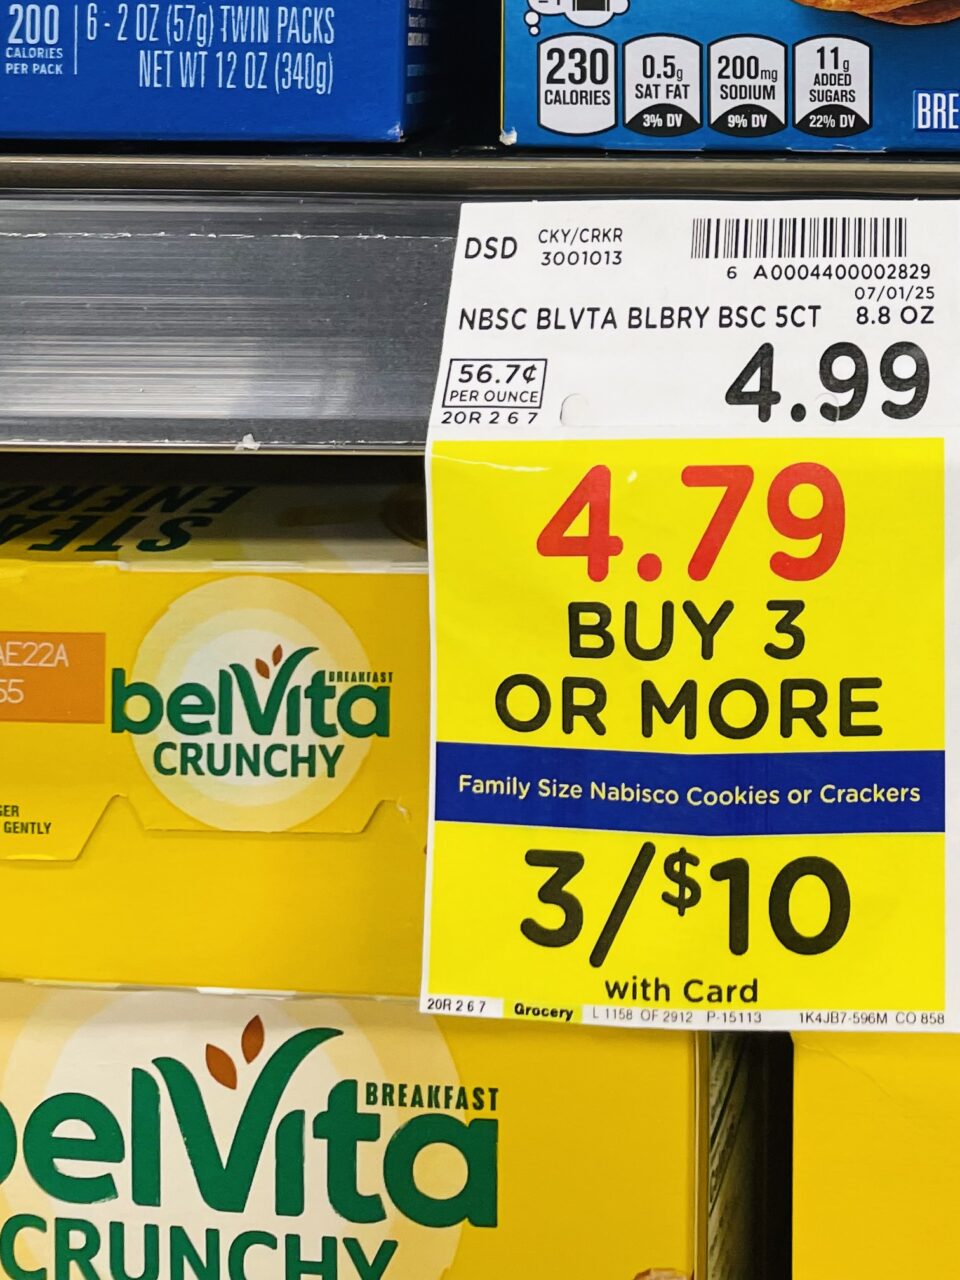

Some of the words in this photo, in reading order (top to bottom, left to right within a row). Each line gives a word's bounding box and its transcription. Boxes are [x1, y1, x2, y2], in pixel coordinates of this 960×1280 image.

[8, 4, 60, 46] 200
[135, 4, 159, 44] OZ
[166, 3, 214, 48] (57g)
[220, 5, 269, 45] TWIN
[278, 6, 335, 45] PACKS
[5, 46, 64, 60] CALORIES
[5, 62, 29, 76] PER
[31, 62, 64, 76] PACK
[139, 49, 174, 89] NET
[179, 49, 208, 89] WT
[216, 50, 235, 90] 12
[245, 51, 268, 91] OZ
[275, 51, 334, 95] (340g)
[545, 47, 609, 85] 230
[813, 72, 852, 87] ADDED
[544, 89, 611, 106] CALORIES
[635, 84, 661, 100] SAT
[666, 84, 690, 100] FAT
[719, 84, 776, 101] SODIUM
[809, 88, 856, 103] SUGARS
[538, 227, 623, 245] CKY/CRKR
[465, 236, 517, 260] DSD
[540, 250, 623, 266] 3001013
[753, 264, 931, 281] A0004400002829
[854, 286, 935, 301] 07/01/25
[459, 307, 527, 331] NBSC
[536, 307, 618, 330] BLVTA
[627, 306, 710, 329] BLBRY
[718, 305, 767, 328] BSC
[775, 305, 822, 328] 5CT
[856, 306, 891, 325] 8.8
[900, 306, 935, 325] OZ
[458, 363, 538, 384] 56.7¢
[725, 341, 930, 423] 4.99
[450, 389, 480, 403] PER
[484, 389, 539, 404] OUNCE
[536, 462, 846, 582] 4.79
[568, 599, 734, 661] BUY
[764, 599, 806, 661] 3
[329, 671, 393, 683] BREAKFAST
[111, 646, 391, 738] belVita
[495, 673, 607, 737] OR
[641, 677, 883, 740] MORE
[153, 742, 345, 778] CRUNCHY
[459, 775, 531, 800] Family
[538, 778, 583, 800] Size
[590, 781, 679, 805] Nabisco
[687, 784, 780, 807] Cookies
[787, 788, 813, 806] or
[820, 783, 921, 805] Crackers
[605, 978, 675, 1003] with
[683, 977, 759, 1004] Card
[514, 1003, 574, 1022] Grocery
[602, 1008, 634, 1022] 1158
[641, 1009, 659, 1023] OF
[662, 1009, 694, 1023] 2912
[707, 1010, 762, 1024] P-15113
[895, 1012, 917, 1025] CO
[920, 1012, 945, 1026] 858
[365, 1081, 499, 1112] BREAKFAST
